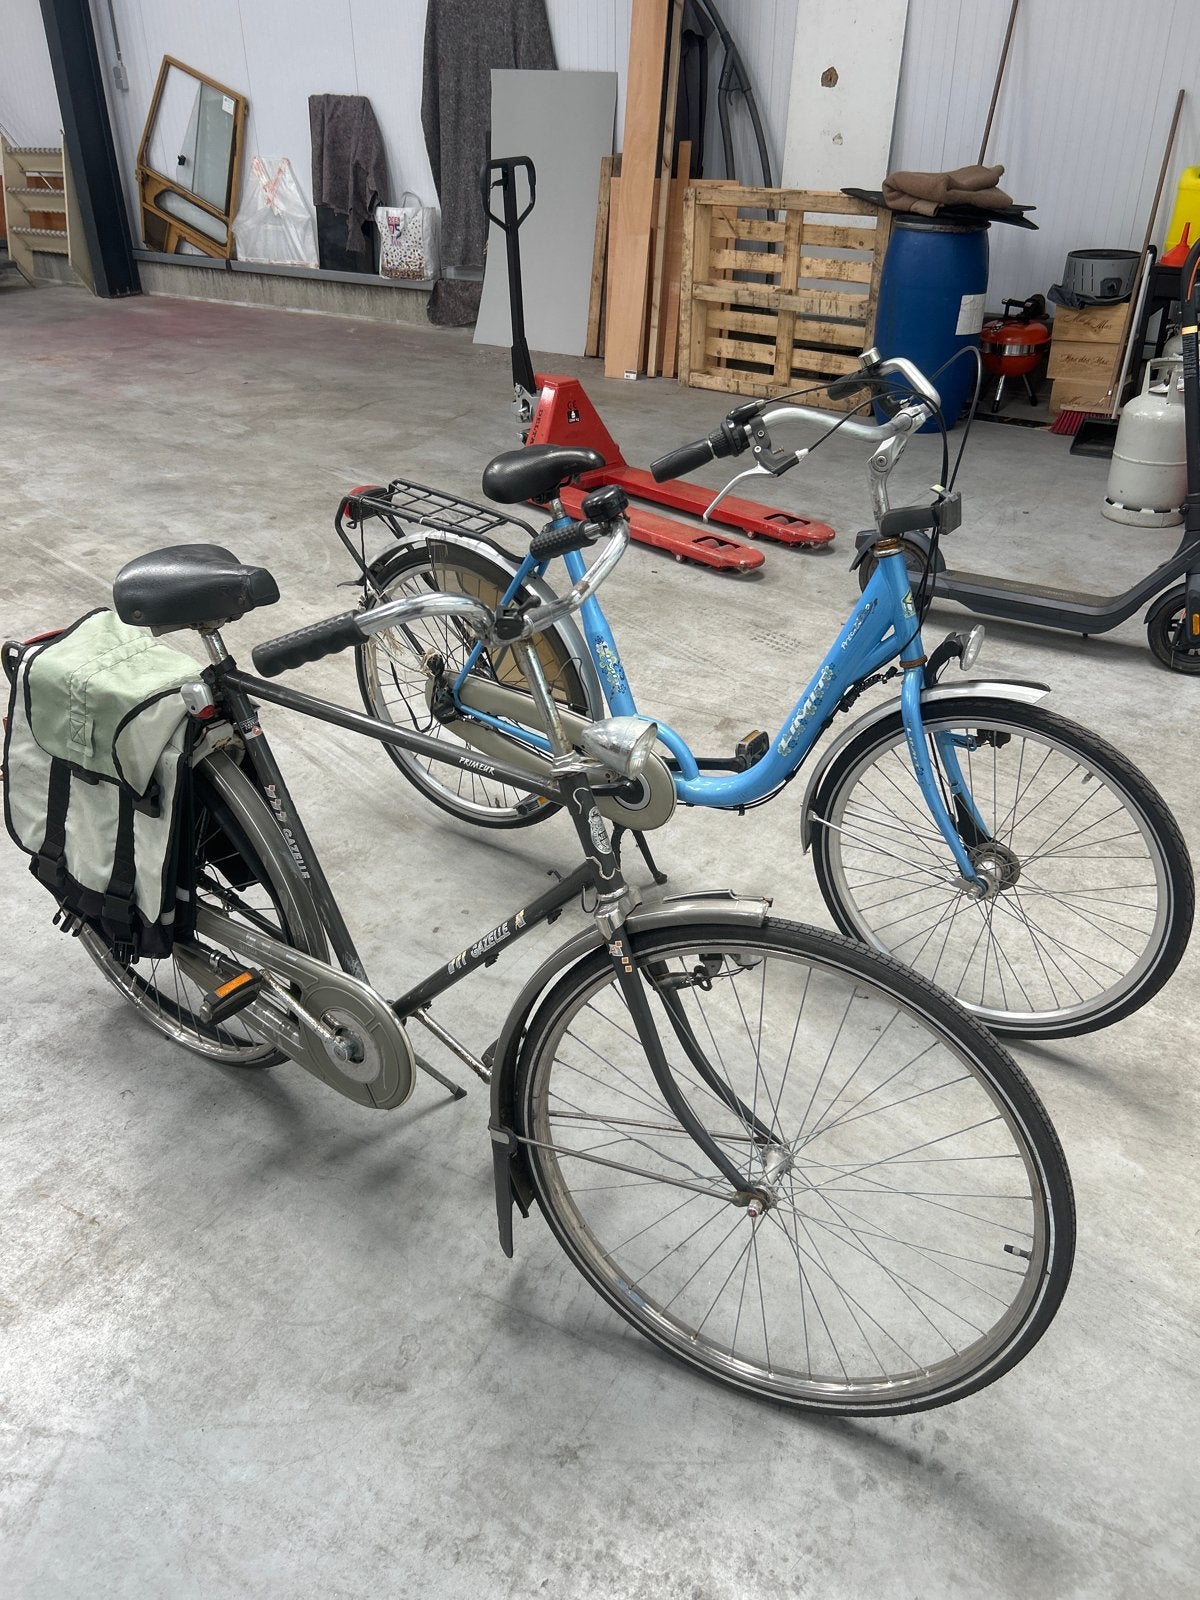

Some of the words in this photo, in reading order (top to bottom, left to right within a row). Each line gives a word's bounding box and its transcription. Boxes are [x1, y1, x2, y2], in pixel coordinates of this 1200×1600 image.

[459, 756, 495, 776] PRIMEUR
[282, 828, 311, 879] GAZELLE
[470, 922, 510, 959] GAZELLE
